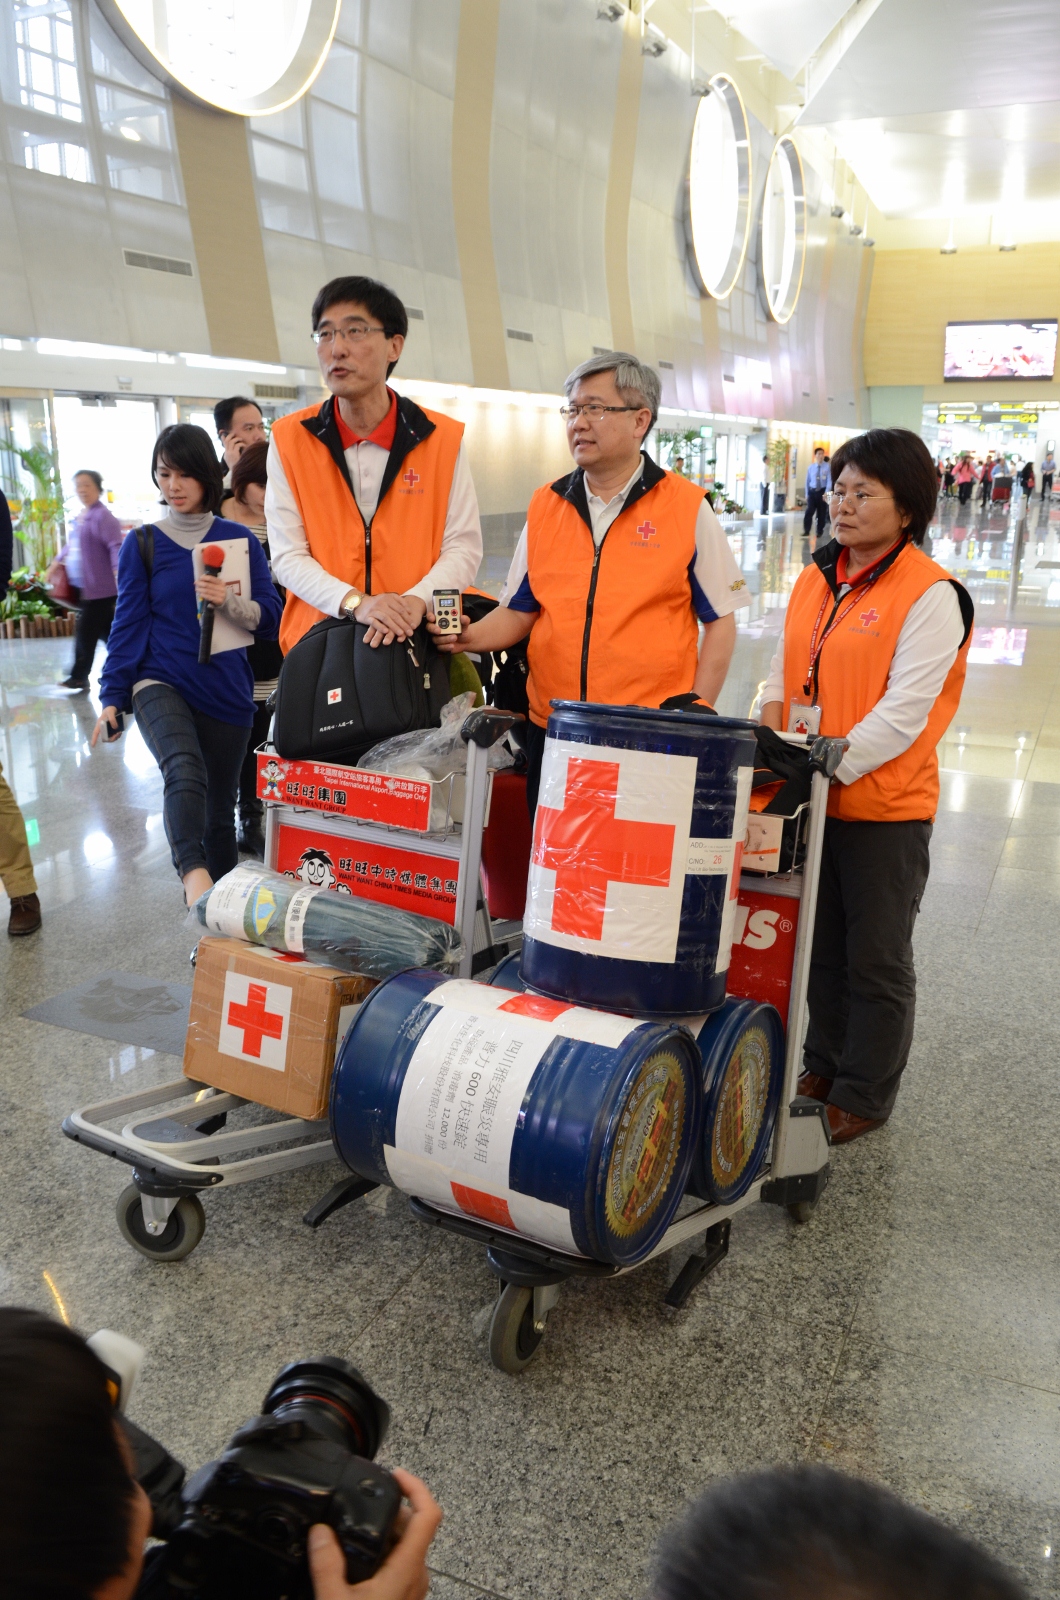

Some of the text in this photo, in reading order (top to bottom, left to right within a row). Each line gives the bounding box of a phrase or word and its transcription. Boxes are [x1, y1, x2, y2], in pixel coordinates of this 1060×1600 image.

[286, 781, 347, 806] 旺旺集團
[323, 775, 338, 785] Taipei
[339, 779, 371, 790] International
[413, 793, 427, 803] Only
[286, 796, 347, 814] WANT WANT GROUP
[713, 854, 722, 864] 26
[338, 872, 456, 904] WANT WANT CHINA TIMES MEDIA GROUP
[339, 858, 458, 895] 旺旺中時媒體集團
[465, 1072, 483, 1097] 600
[438, 1106, 451, 1138] 12,000
